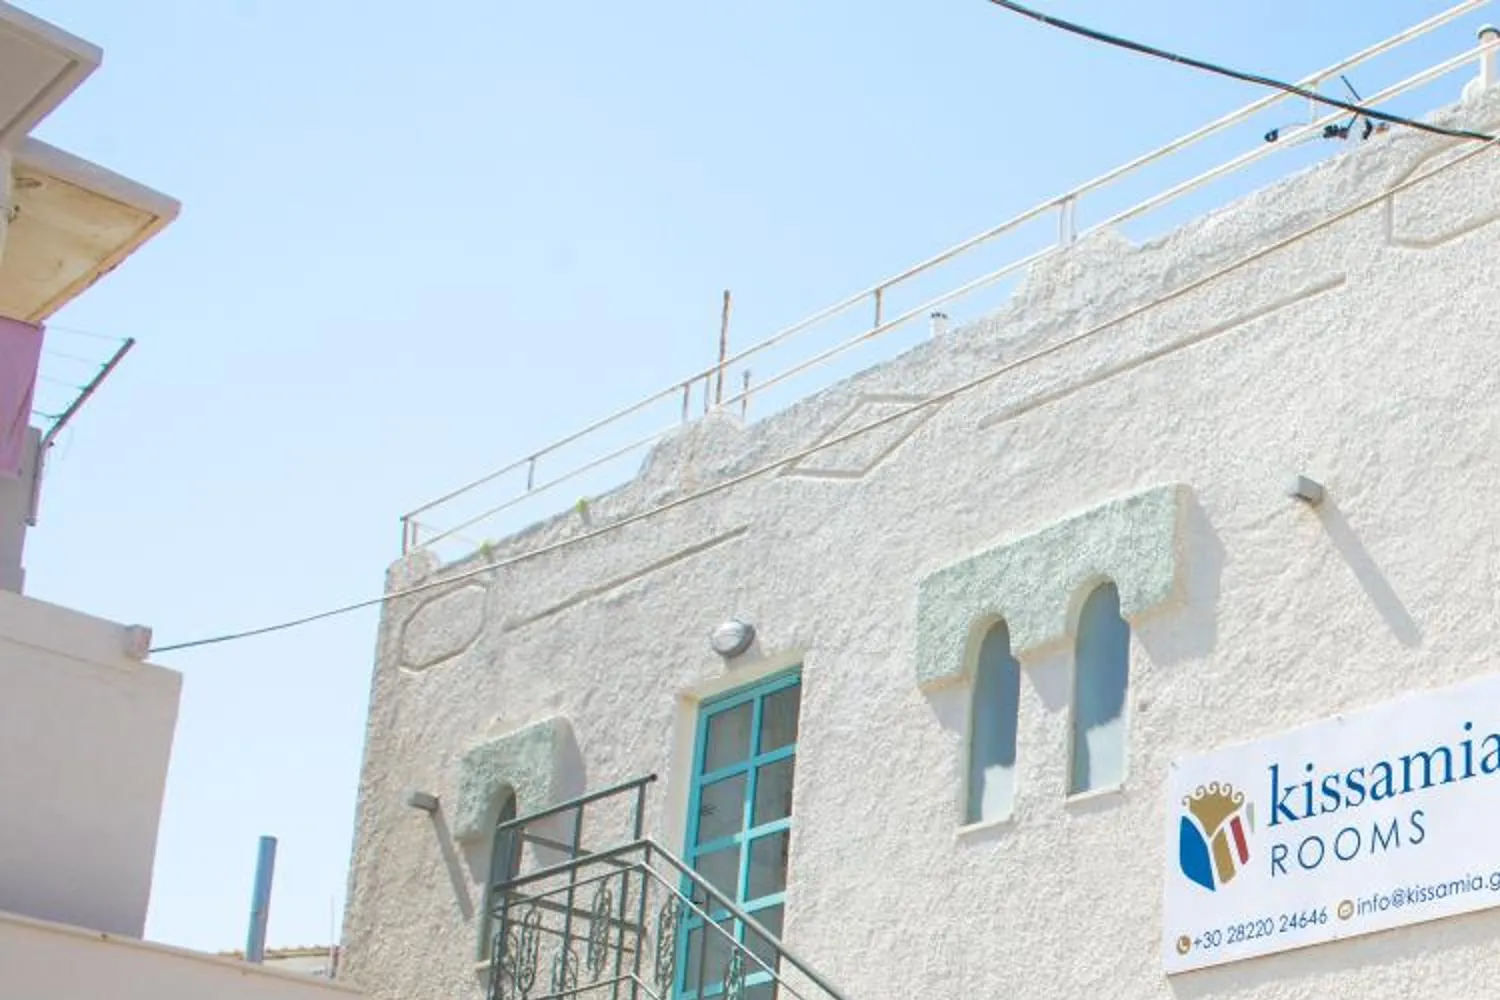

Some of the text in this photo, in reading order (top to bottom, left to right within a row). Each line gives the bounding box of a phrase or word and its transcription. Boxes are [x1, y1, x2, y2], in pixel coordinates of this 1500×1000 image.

[1271, 809, 1426, 877] ROOMS
[1193, 930, 1222, 949] +30
[1227, 917, 1274, 944] 28220
[1280, 906, 1328, 933] 24646
